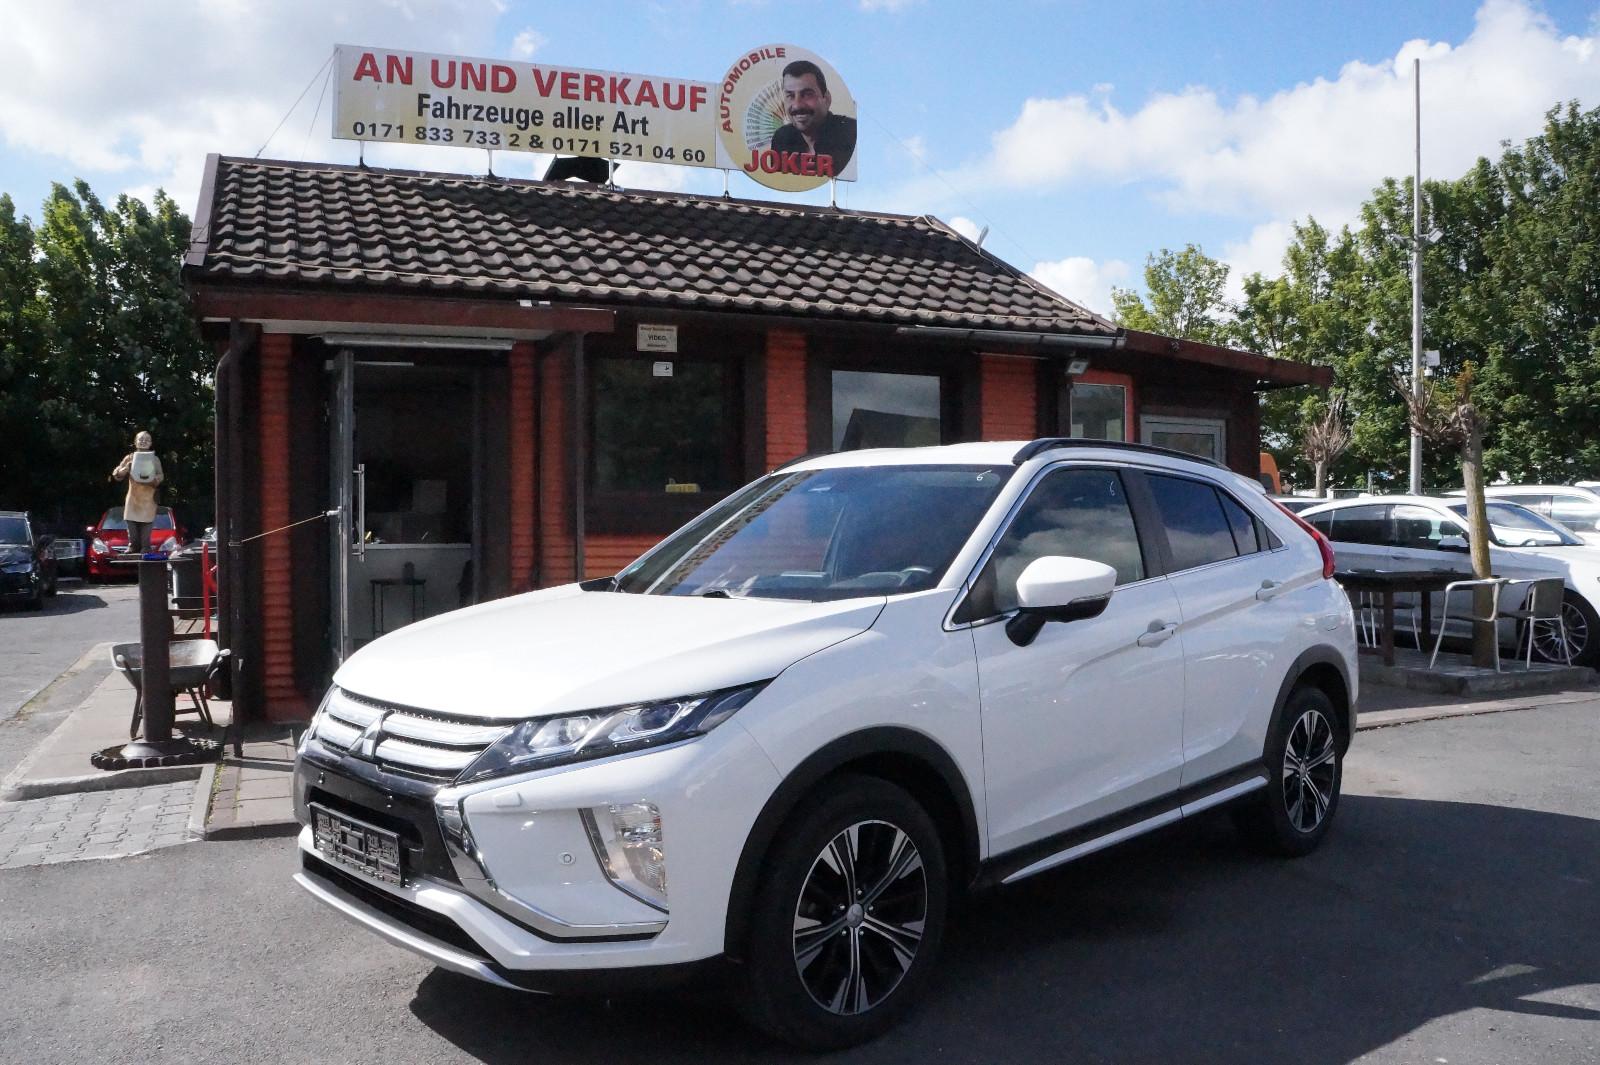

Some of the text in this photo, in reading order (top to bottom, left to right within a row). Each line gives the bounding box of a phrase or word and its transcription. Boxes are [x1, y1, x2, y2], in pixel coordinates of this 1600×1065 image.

[353, 53, 707, 112] AN UND VERKAUF
[720, 47, 786, 133] AUTOMOBILE
[417, 93, 649, 136] Fahrzeuge aller Art
[353, 122, 705, 163] 0171 833 733 2 & 0171 521 04 60
[744, 149, 833, 177] JOKER
